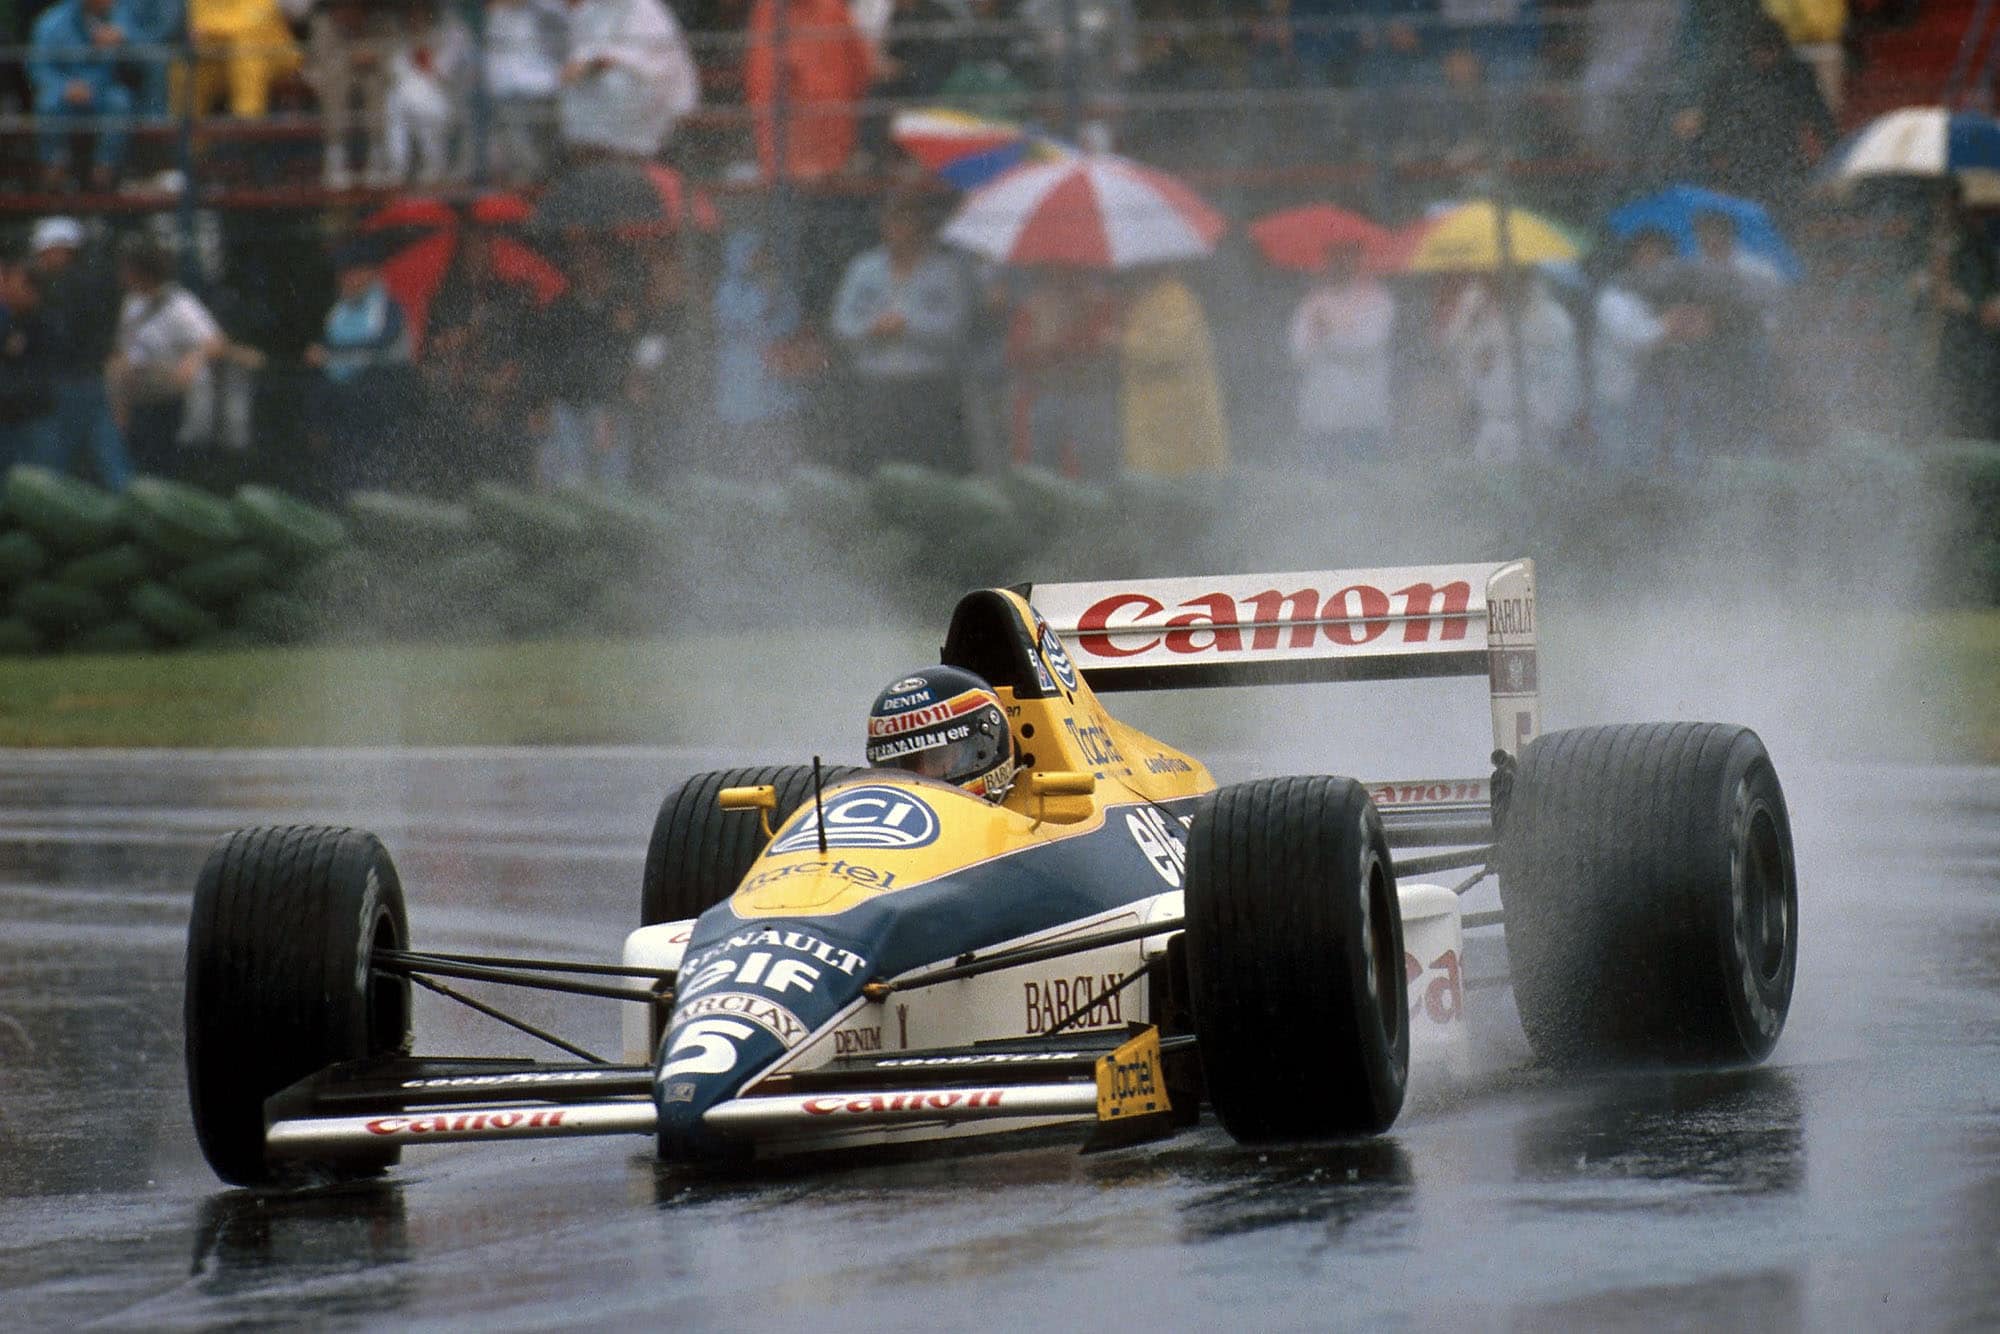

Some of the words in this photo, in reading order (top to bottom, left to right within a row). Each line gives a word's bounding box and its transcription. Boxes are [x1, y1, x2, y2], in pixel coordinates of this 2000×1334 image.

[1077, 580, 1471, 658] Canon
[883, 690, 931, 711] DENIM
[874, 703, 950, 735] Canon
[1370, 784, 1481, 802] anon
[800, 798, 914, 831] ICI
[1024, 973, 1125, 1034] BARCLAY
[657, 1019, 756, 1082] 5
[834, 1026, 882, 1054] DENIM
[802, 1089, 1004, 1116] Canon
[366, 1111, 566, 1136] Canon
